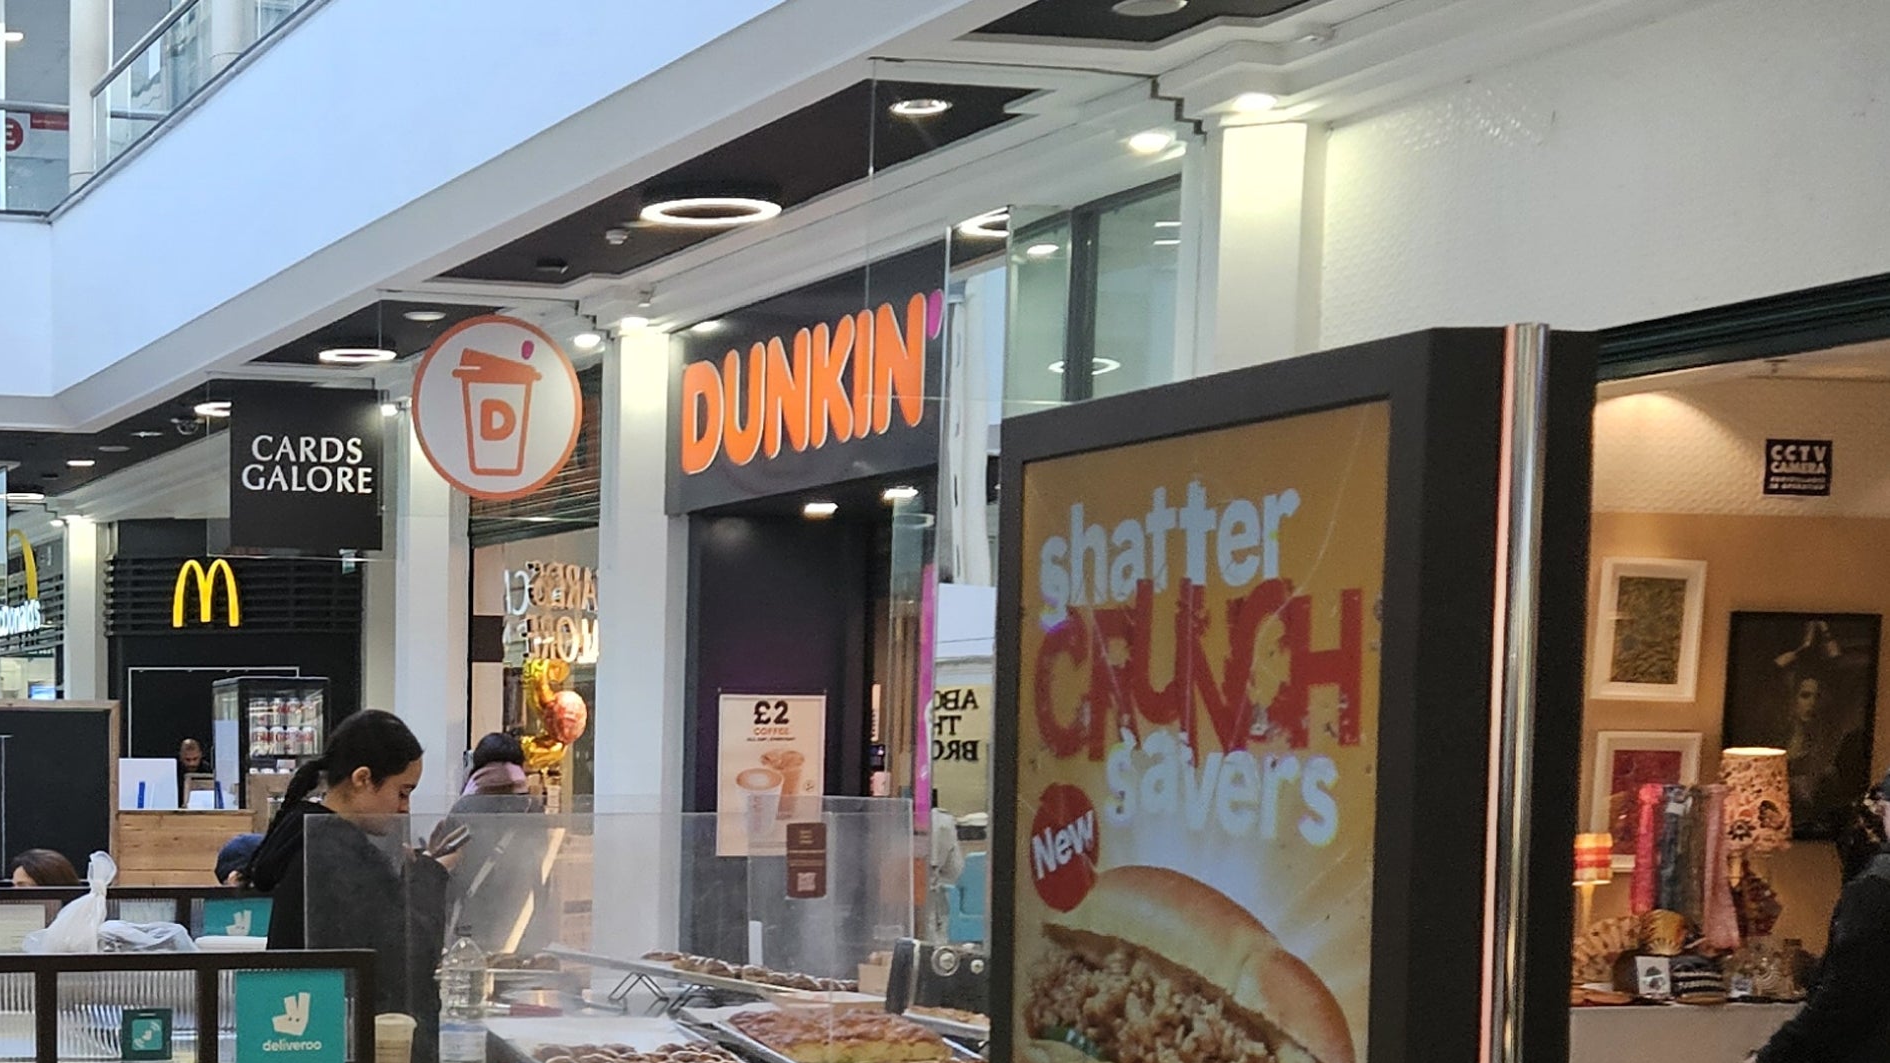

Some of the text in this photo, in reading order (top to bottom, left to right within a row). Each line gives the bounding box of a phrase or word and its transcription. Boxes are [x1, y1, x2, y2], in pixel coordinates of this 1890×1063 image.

[681, 288, 944, 475] DUNKIN'
[251, 434, 363, 465] CARDS
[1770, 444, 1827, 462] CCTV
[241, 464, 373, 494] GALORE
[1770, 461, 1827, 475] CAMERA
[1039, 478, 1301, 631] shatter
[1034, 577, 1364, 768] CRUNCH
[753, 700, 790, 725] £2
[753, 727, 790, 736] COFFEE
[1103, 728, 1339, 847] savers
[1031, 808, 1096, 880] New
[262, 1038, 322, 1051] deliveroo
